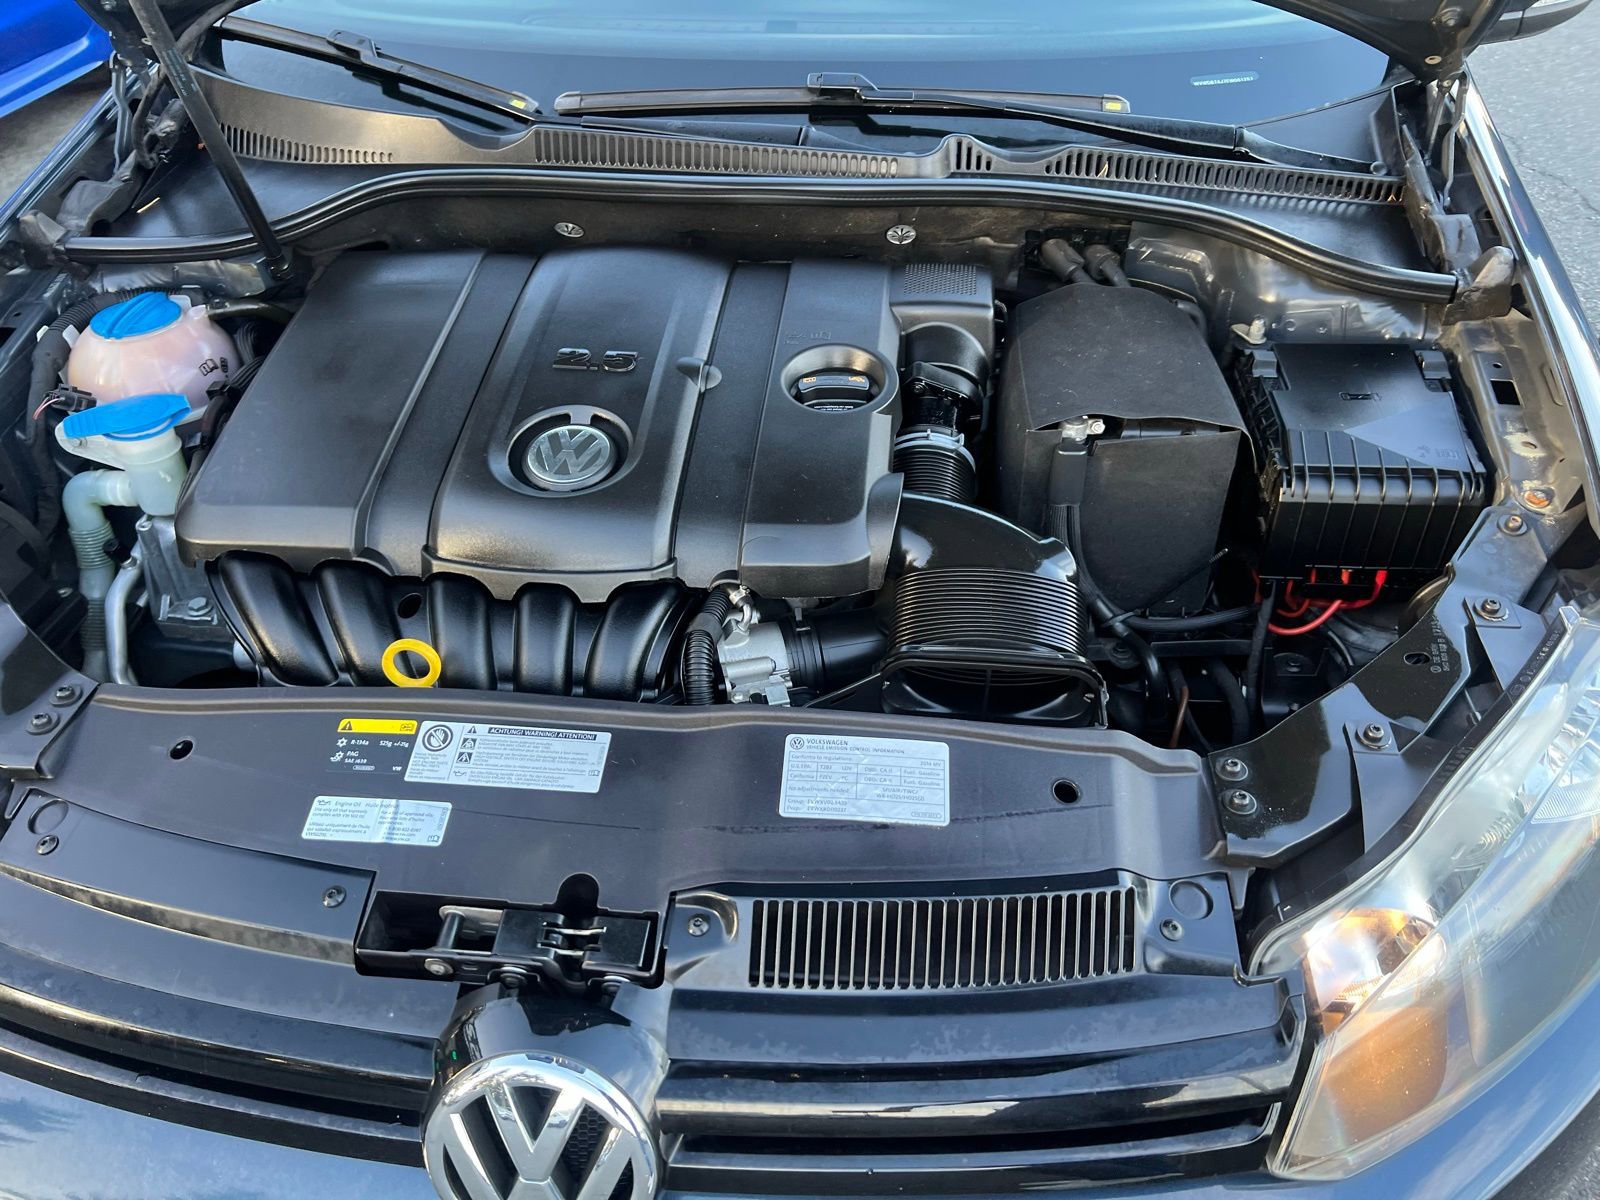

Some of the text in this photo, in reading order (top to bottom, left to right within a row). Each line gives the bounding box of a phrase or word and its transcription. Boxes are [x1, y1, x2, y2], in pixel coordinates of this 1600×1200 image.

[552, 347, 639, 372] 2.5
[490, 728, 595, 740] ACHTUNG! WARNING! ATTENTION!
